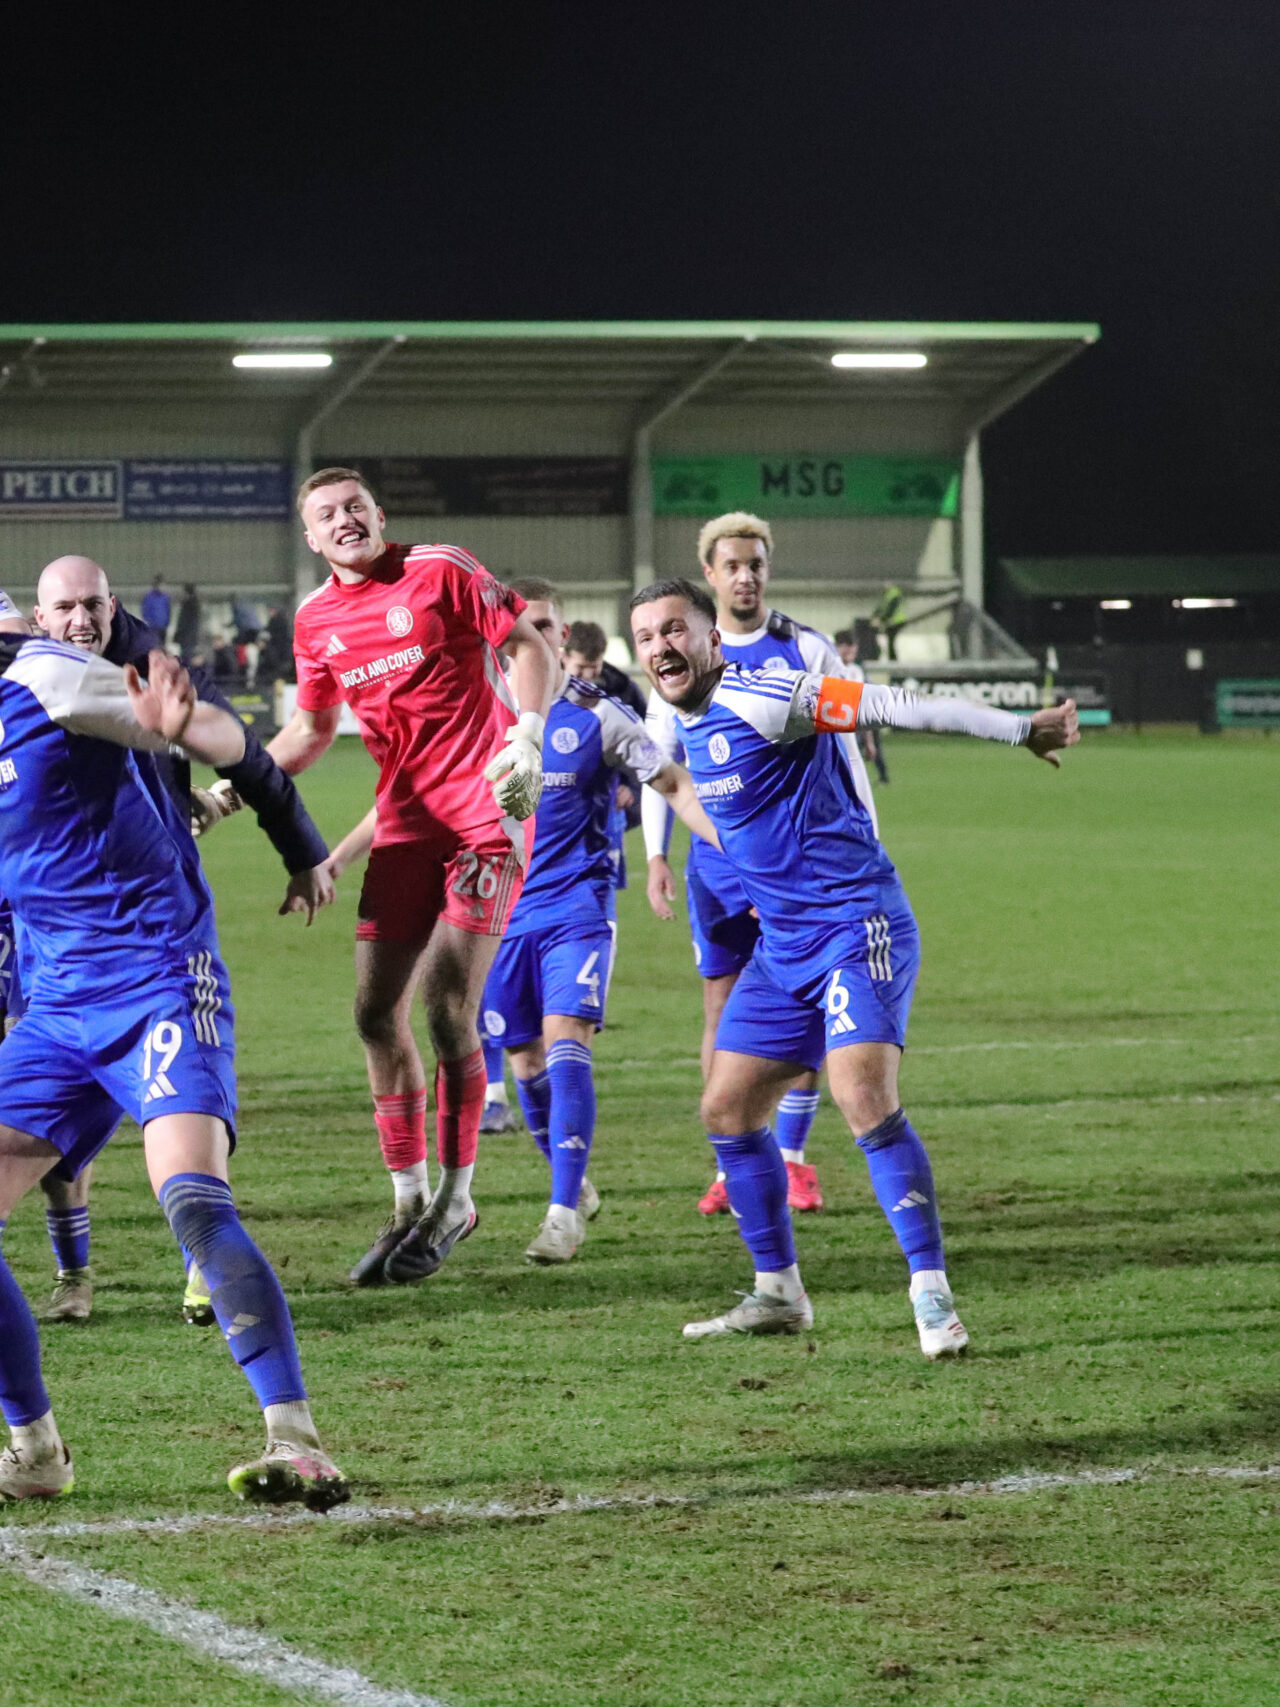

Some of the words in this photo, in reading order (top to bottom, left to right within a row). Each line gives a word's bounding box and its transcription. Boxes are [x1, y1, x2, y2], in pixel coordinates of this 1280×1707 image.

[3, 470, 114, 499] PETCH
[762, 462, 844, 497] MSG
[367, 658, 390, 679] AND
[387, 644, 426, 671] COVER
[821, 700, 854, 727] C
[453, 851, 499, 899] 26
[576, 951, 600, 991] 4
[827, 968, 850, 1015] 6
[143, 1020, 183, 1081] 19
